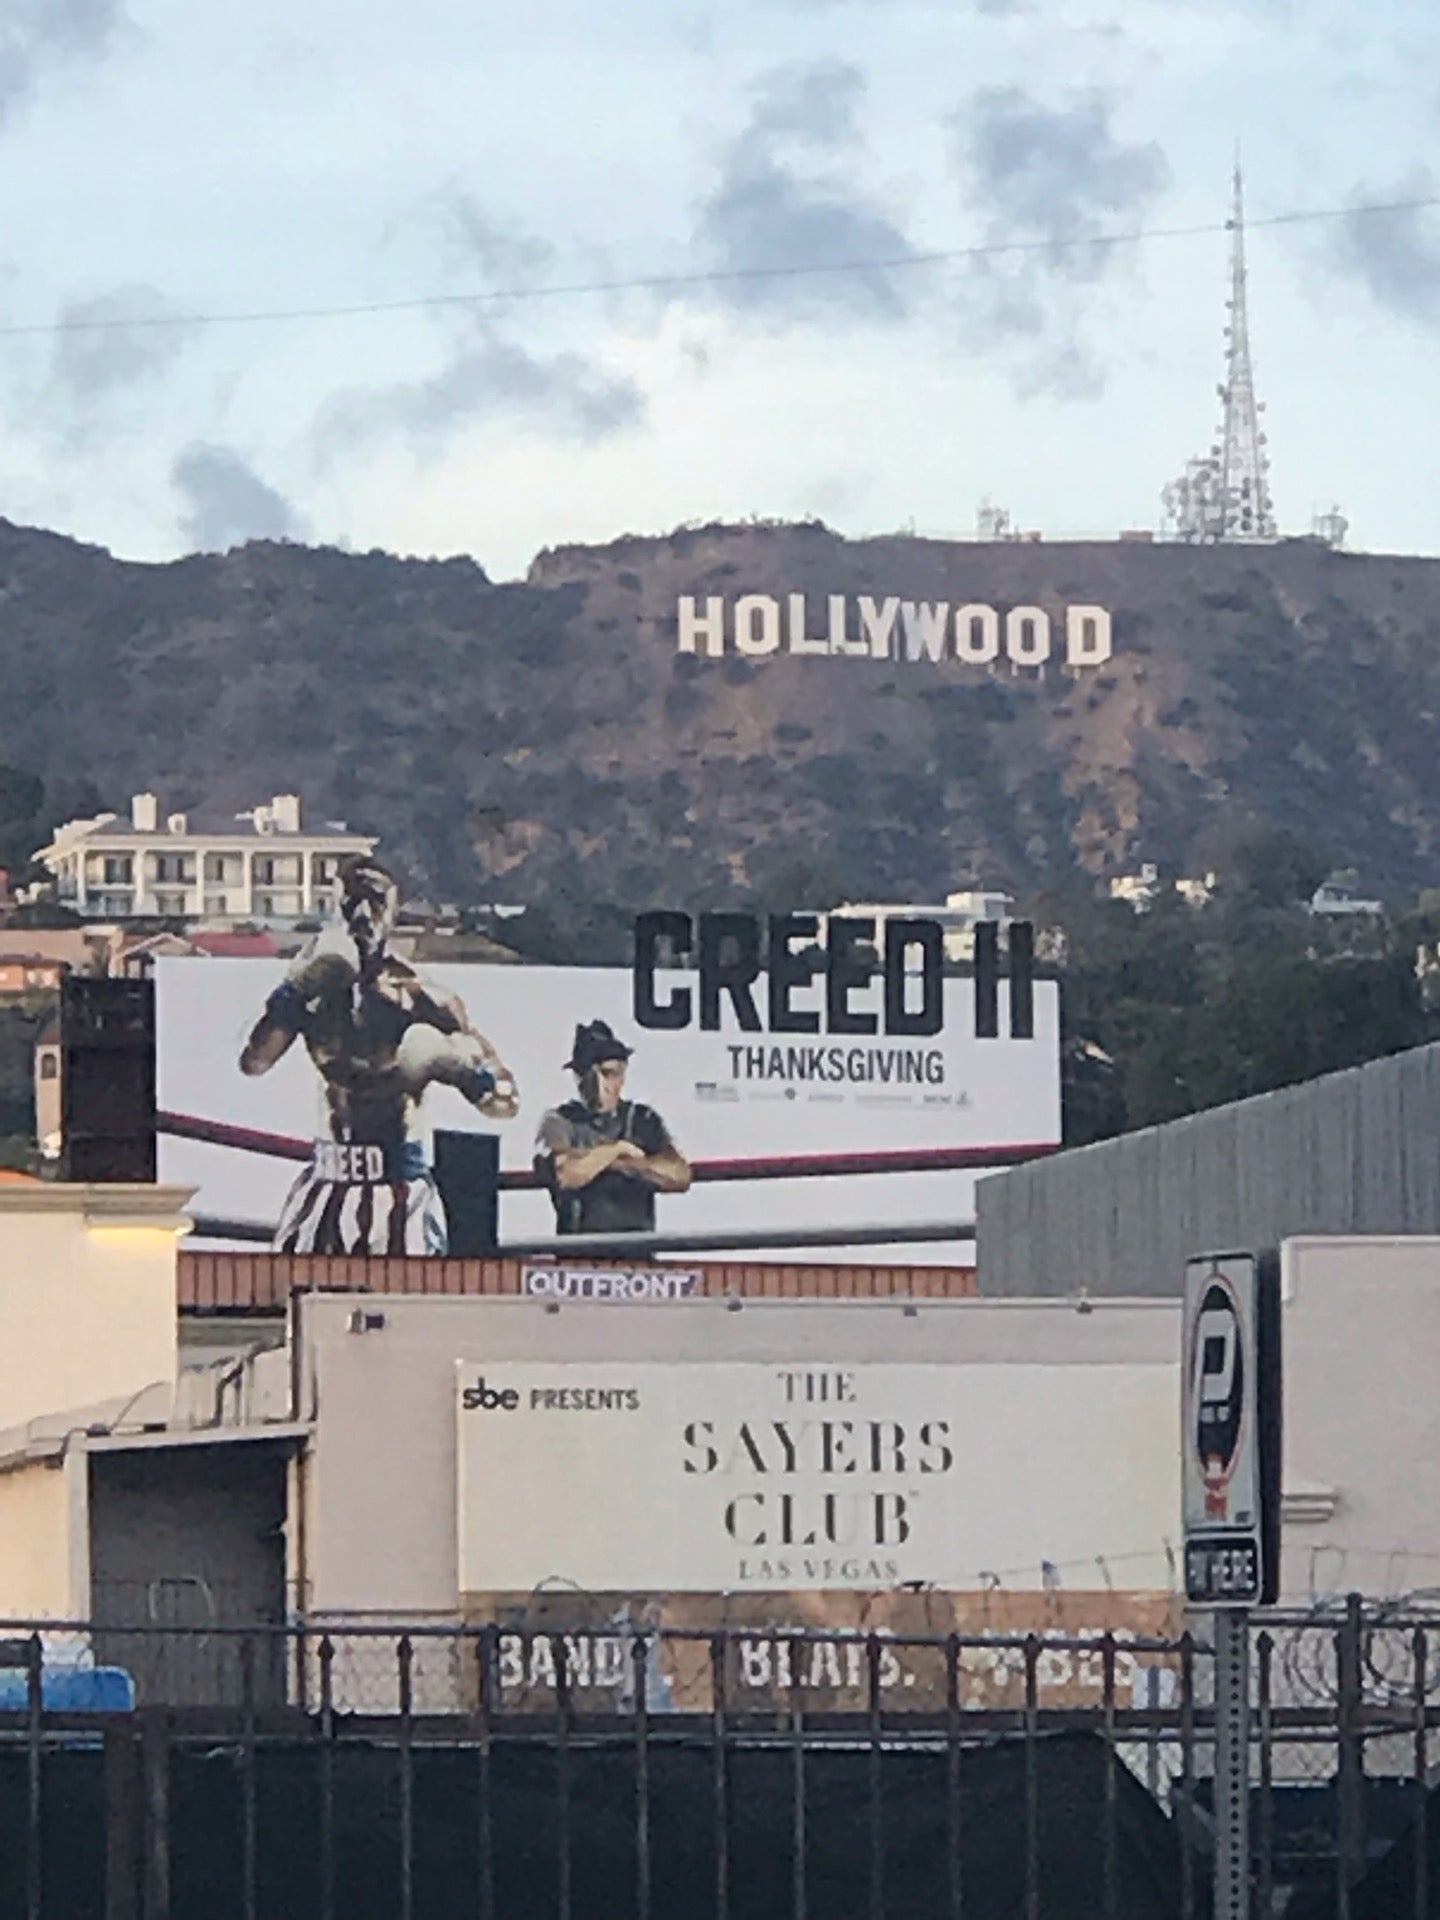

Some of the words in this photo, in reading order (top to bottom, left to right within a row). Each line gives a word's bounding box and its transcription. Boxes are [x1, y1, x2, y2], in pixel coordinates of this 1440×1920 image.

[677, 594, 1112, 666] HOLLYWOOD
[633, 911, 943, 1036] CREED
[974, 921, 1034, 1039] II
[727, 1045, 945, 1084] THANKSGIVING
[529, 1270, 691, 1298] OUTFRONT
[462, 1377, 519, 1410] sbe
[529, 1388, 640, 1410] PRESENTS
[776, 1373, 856, 1402] THE
[682, 1421, 953, 1474] SAYERS
[724, 1493, 911, 1545] CLUB
[738, 1560, 791, 1580] LAS
[802, 1560, 897, 1580] VEGAS
